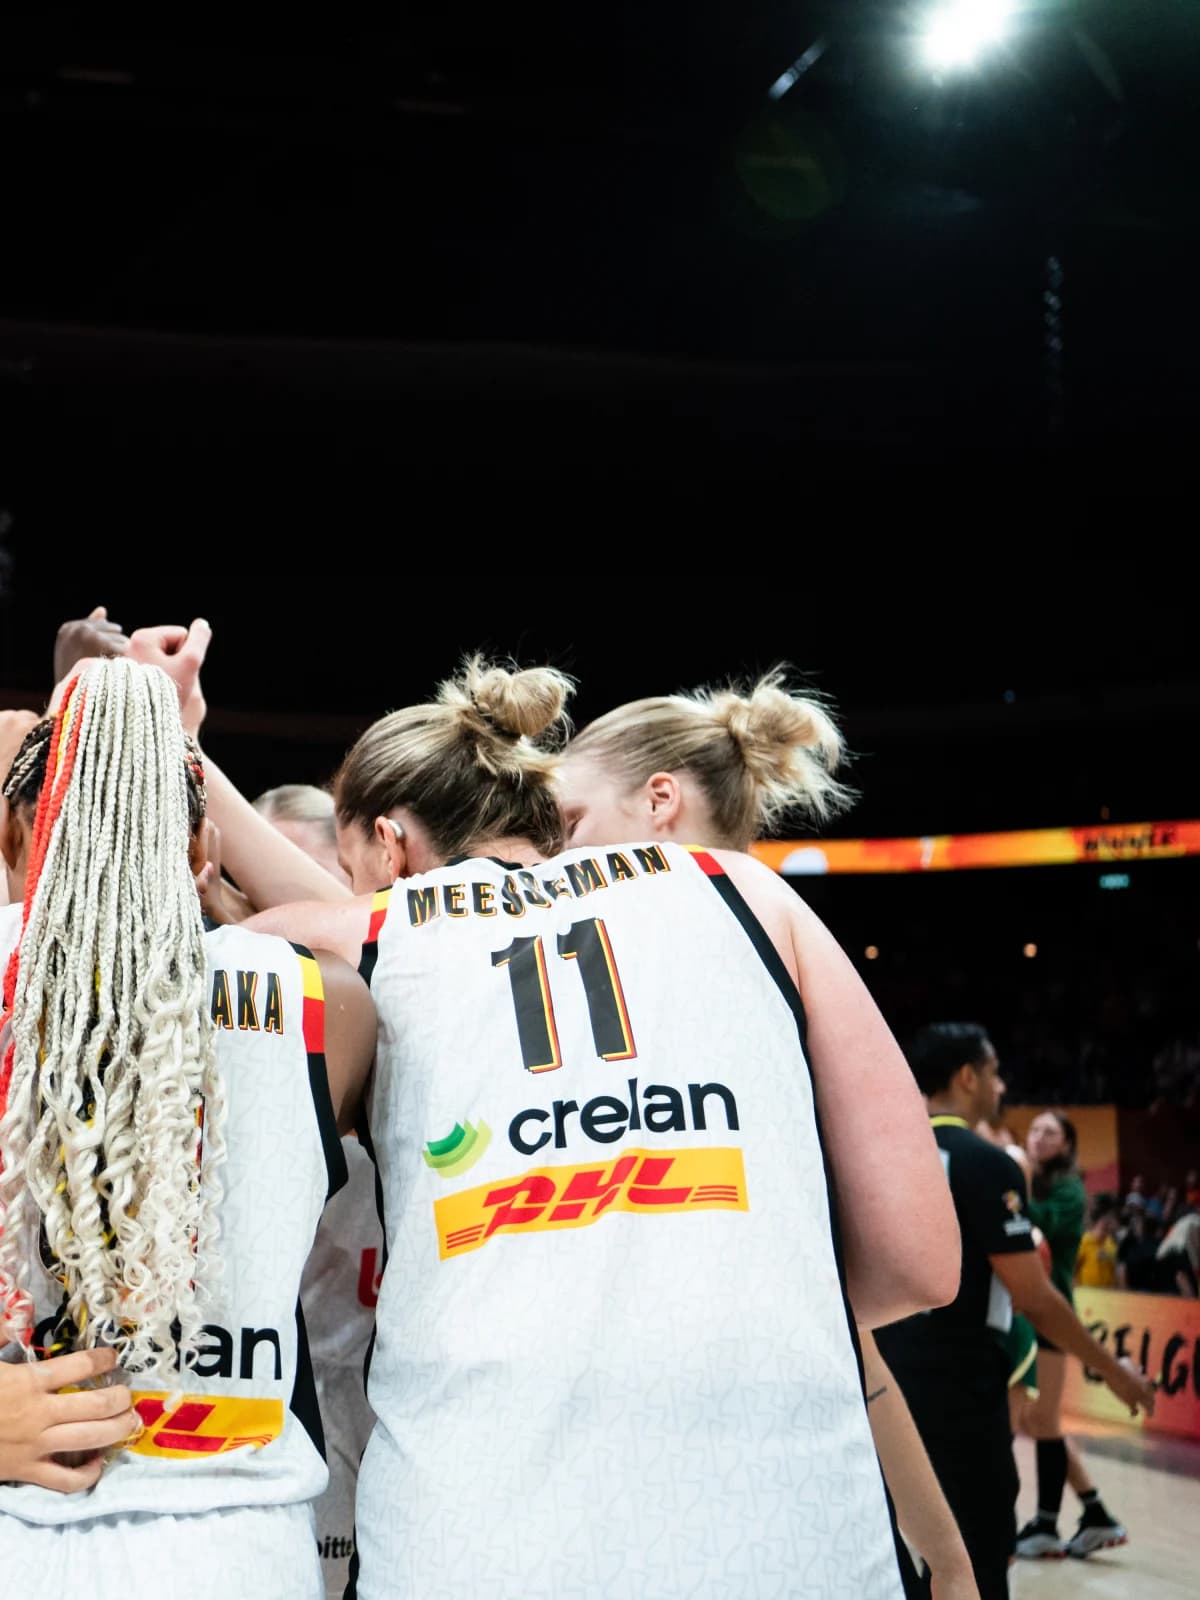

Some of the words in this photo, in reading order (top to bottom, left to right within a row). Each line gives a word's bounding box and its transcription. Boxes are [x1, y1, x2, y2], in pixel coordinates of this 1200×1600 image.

[407, 845, 671, 927] MEESSEMAN
[491, 917, 638, 1074] 11
[508, 1077, 740, 1155] crelan
[482, 1155, 692, 1239] DHL
